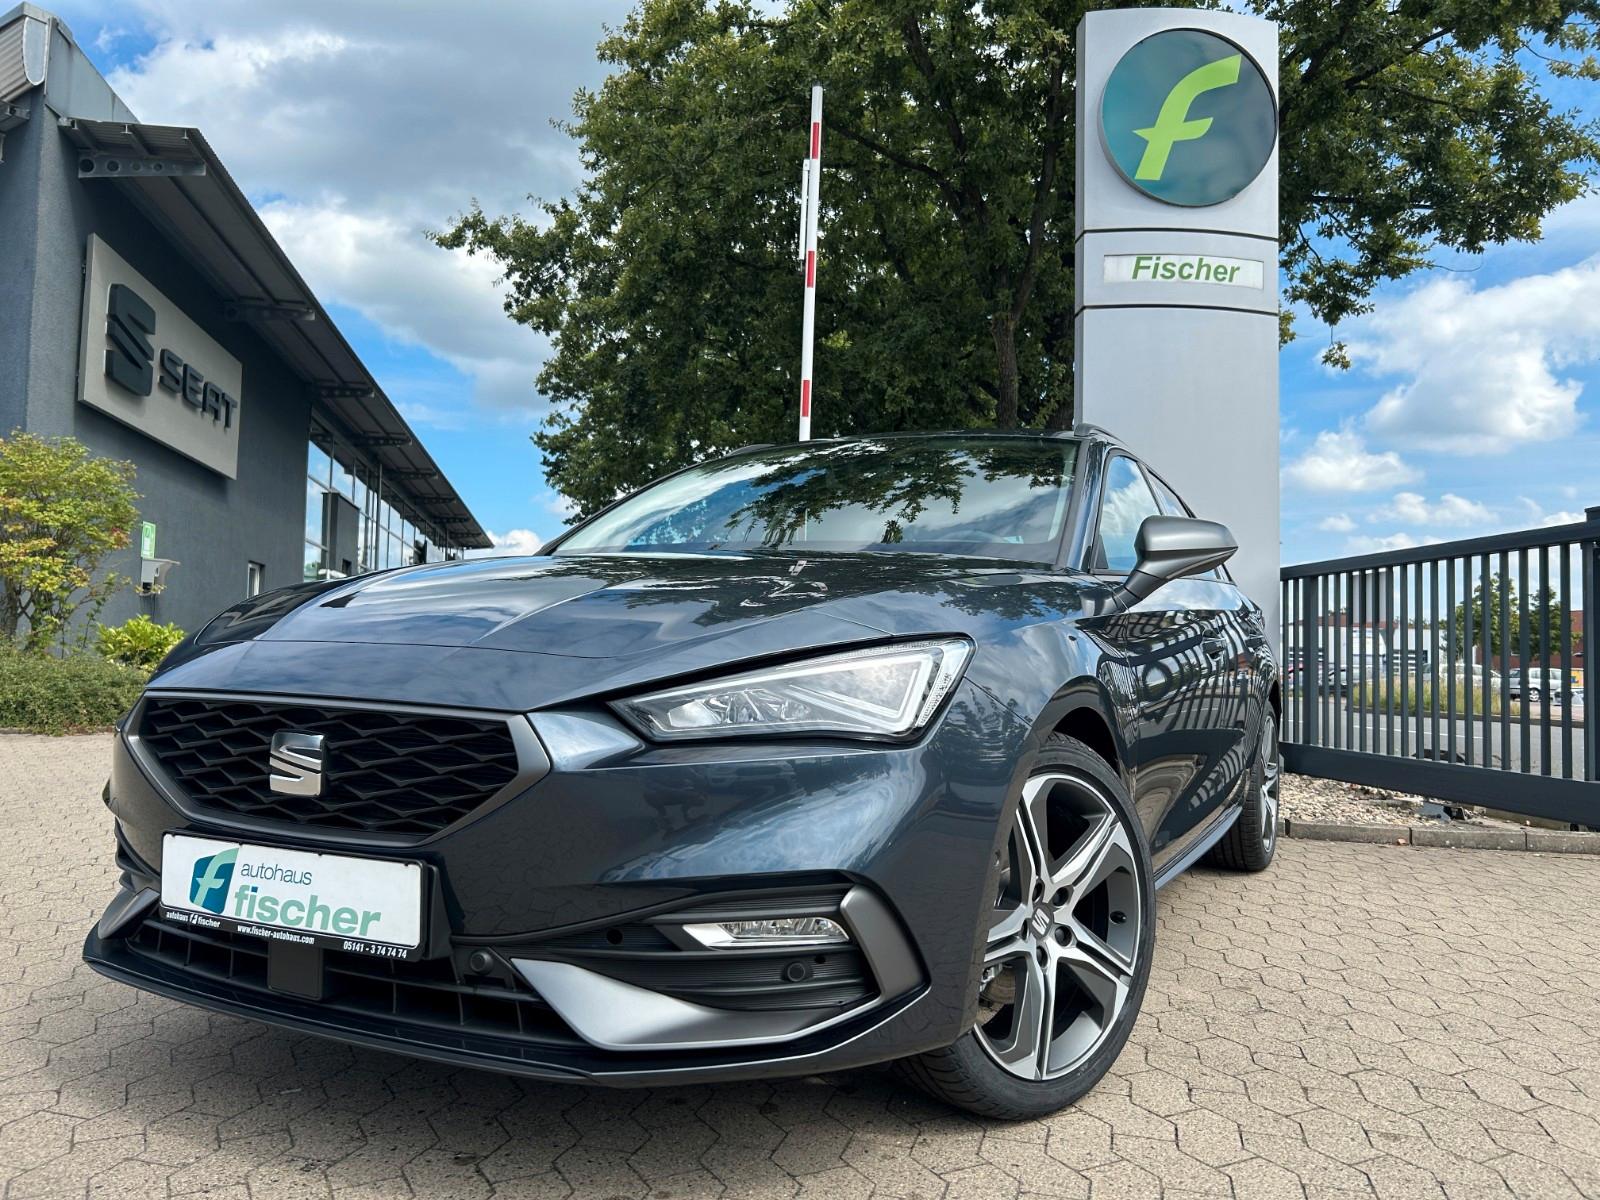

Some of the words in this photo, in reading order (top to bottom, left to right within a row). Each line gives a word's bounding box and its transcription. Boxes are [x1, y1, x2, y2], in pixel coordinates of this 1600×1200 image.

[1131, 256, 1241, 283] Fischer
[159, 348, 238, 428] SEAT
[240, 862, 313, 886] autohaus
[166, 910, 188, 923] autohaus
[198, 915, 221, 929] fischer
[234, 884, 382, 937] fischer
[237, 924, 315, 945] www.fischer-autohaus.com
[343, 941, 364, 952] 05141
[370, 945, 376, 954] 3
[377, 946, 386, 956] 74
[387, 948, 396, 957] 74
[398, 949, 407, 958] 74
